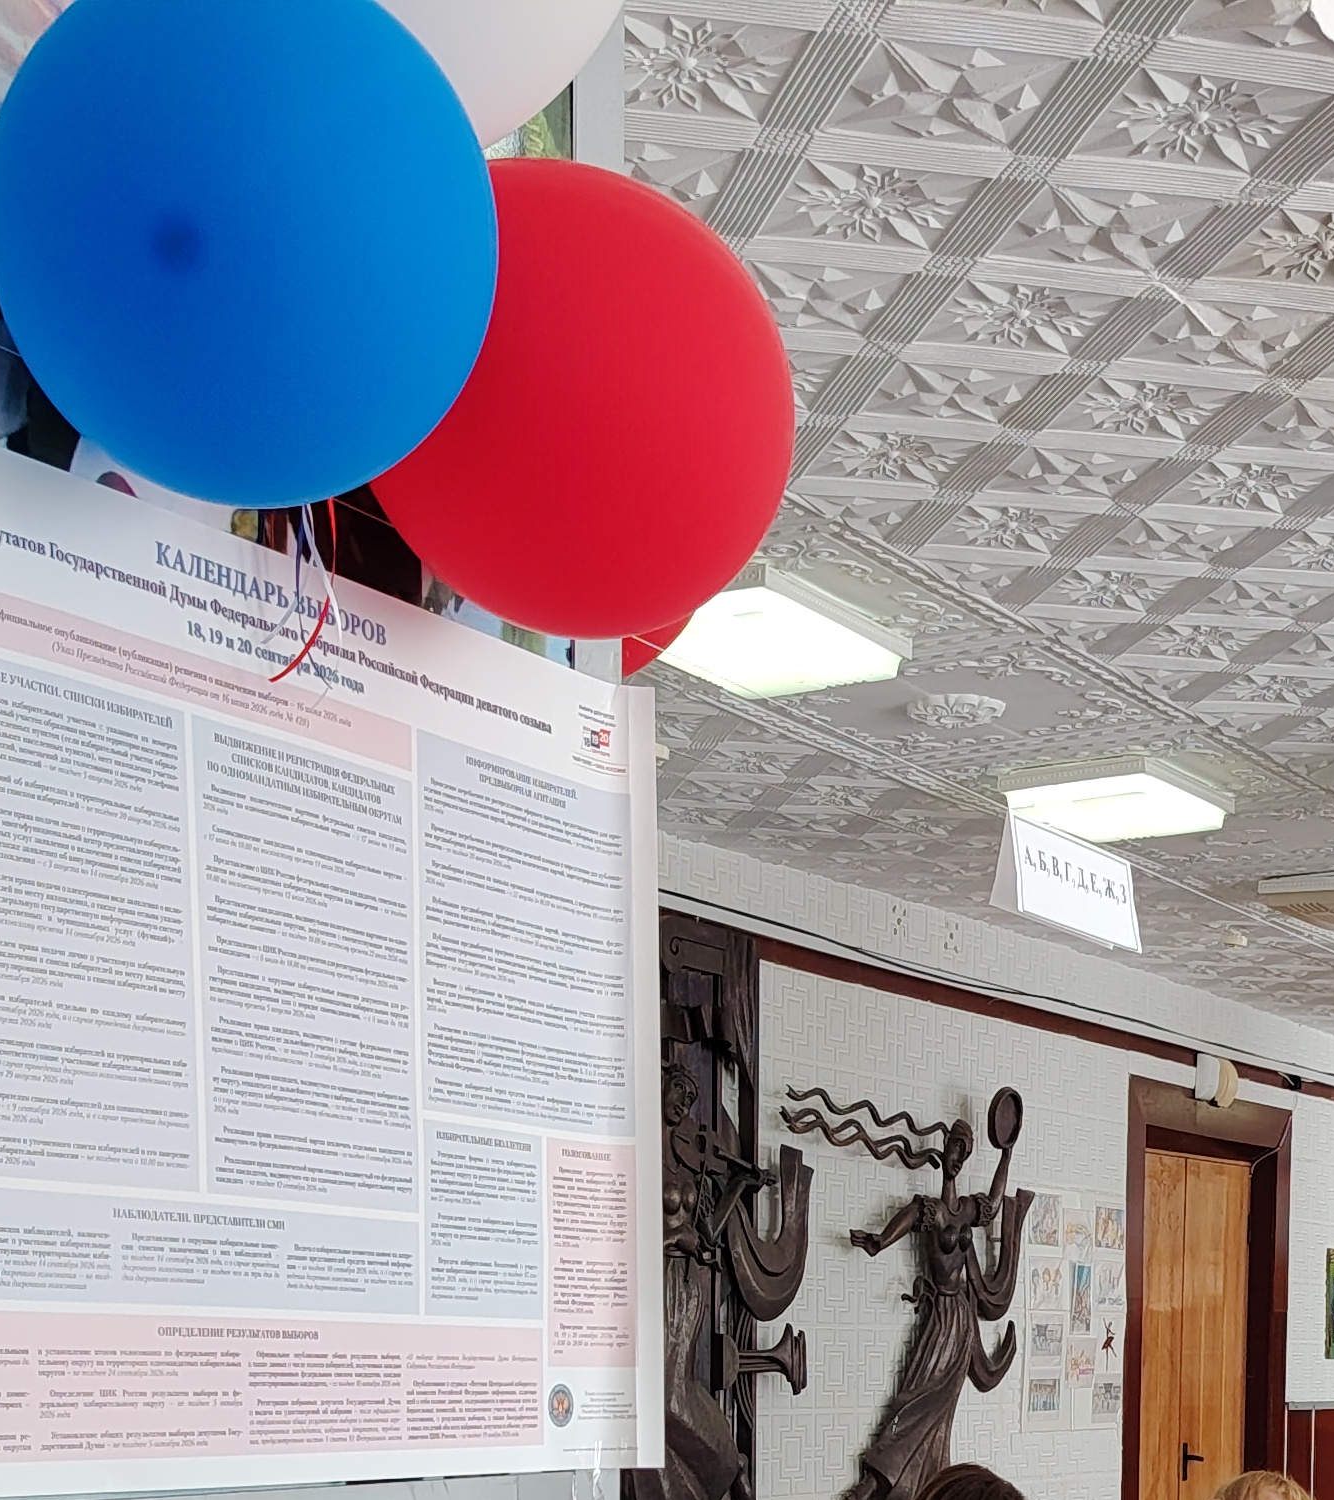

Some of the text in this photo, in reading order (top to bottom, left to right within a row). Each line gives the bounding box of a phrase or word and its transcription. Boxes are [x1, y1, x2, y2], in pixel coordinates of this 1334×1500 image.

[155, 541, 289, 609] КАЛЕНДАРЬ
[48, 541, 167, 600] Государственной
[169, 582, 208, 611] Думы
[301, 629, 356, 663] Сбрания
[357, 648, 418, 686] Российской
[419, 673, 474, 706] Федерации
[476, 697, 518, 722] девятого
[519, 713, 552, 735] созыва
[187, 620, 206, 641] 18,
[209, 627, 223, 646] 19
[226, 635, 235, 650] и
[237, 636, 252, 655] 20
[340, 675, 364, 694] года
[9, 673, 61, 699] УЧАСТКИ.
[63, 689, 105, 710] СПИСКИ
[107, 700, 173, 730] ИЗБИРАТЕЛЕЙ
